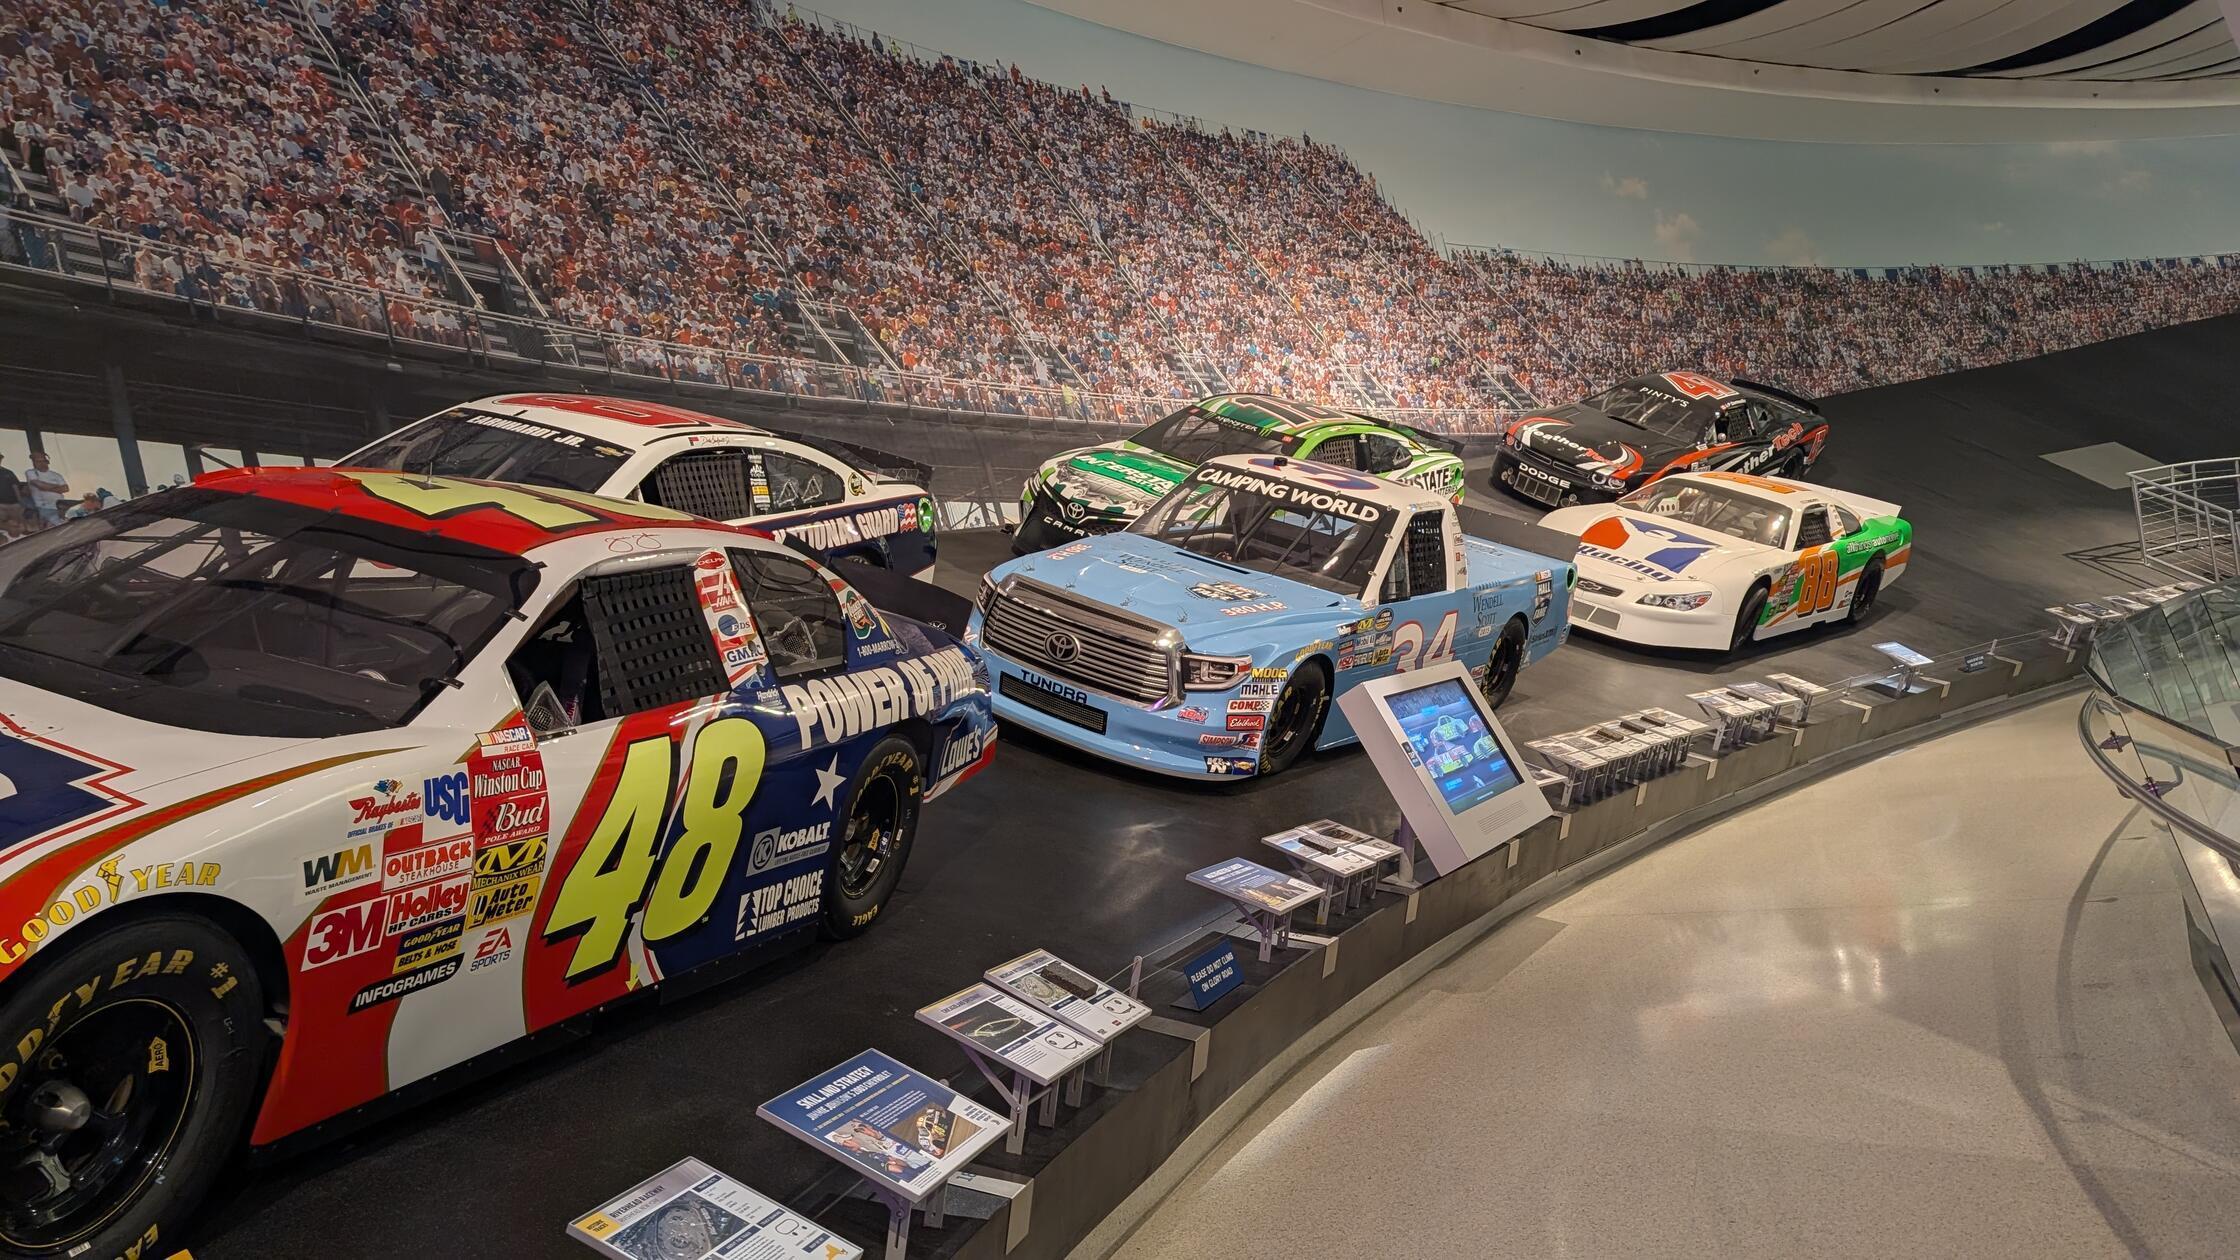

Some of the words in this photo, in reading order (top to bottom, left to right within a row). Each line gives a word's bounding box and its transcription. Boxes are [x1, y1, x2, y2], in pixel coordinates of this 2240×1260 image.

[1640, 387, 1690, 408] PINTY'S
[466, 415, 560, 440] EARNHARDT
[554, 433, 586, 448] JR.
[1216, 415, 1258, 432] MONSTER
[1075, 455, 1175, 490] INTERSTA
[1519, 463, 1571, 489] DODGE
[1196, 467, 1290, 503] CAMPING
[1290, 488, 1380, 522] WORLD
[855, 507, 899, 540] GUARD
[1796, 550, 1838, 617] 88
[1220, 605, 1256, 617] 380
[1473, 594, 1504, 613] WENDELL
[730, 621, 751, 633] EDS
[1476, 612, 1498, 628] SCOTT
[1021, 669, 1087, 706] TUNDRA
[1251, 667, 1288, 679] MOOG
[781, 667, 909, 750] POWER
[896, 658, 936, 716] OF
[925, 647, 977, 705] PRIDE
[1241, 684, 1279, 696] MAHLE
[1229, 700, 1261, 712] COMP
[494, 727, 527, 743] NASCAR
[1229, 717, 1261, 728] Edelbrock
[504, 744, 518, 754] RACE
[519, 742, 535, 752] CAR
[940, 725, 982, 778] LOWE'S
[1202, 735, 1234, 746] SIMPSON
[474, 771, 519, 799] Winston
[519, 766, 544, 793] Cup
[348, 792, 422, 824] Raybestos
[424, 771, 471, 826] USG
[496, 797, 547, 832] Bud
[484, 831, 509, 845] POLE
[510, 825, 541, 839] AWARD
[543, 717, 766, 980] 48
[777, 821, 831, 853] KOBALT
[386, 840, 473, 876] OUTBACK
[399, 861, 460, 884] STEAKHOUSE
[305, 884, 328, 895] WASTE
[327, 872, 373, 890] MANAGEMENT
[473, 872, 518, 890] MECHANIX
[517, 861, 545, 878] WEAR
[390, 879, 470, 923] Holley
[490, 882, 529, 903] Auto
[760, 885, 783, 914] TOP
[783, 869, 825, 903] CHOICE
[388, 919, 409, 934] HP
[410, 907, 453, 928] CARBS
[486, 895, 534, 923] Meter
[758, 912, 785, 932] LUMBER
[785, 898, 821, 924] PRODUCTS
[307, 900, 387, 965] 3M
[475, 928, 512, 960] EA
[397, 950, 424, 968] BELTS
[424, 948, 432, 958] &
[432, 939, 458, 955] HOSE
[470, 950, 511, 972] SPORTS
[355, 960, 456, 1007] INFOGRAMES
[1191, 968, 1208, 984] PLEASE
[1206, 963, 1214, 975] DO
[1201, 981, 1210, 992] ON
[1208, 972, 1222, 988] GLORY
[1221, 966, 1234, 979] ROAD
[154, 1041, 166, 1068] AERO
[796, 1092, 826, 1109] SKILL
[818, 1083, 841, 1101] AND
[833, 1065, 875, 1090] STRATEGY
[609, 1198, 642, 1219] RIVERHEAD
[640, 1185, 664, 1203] RACEWAY
